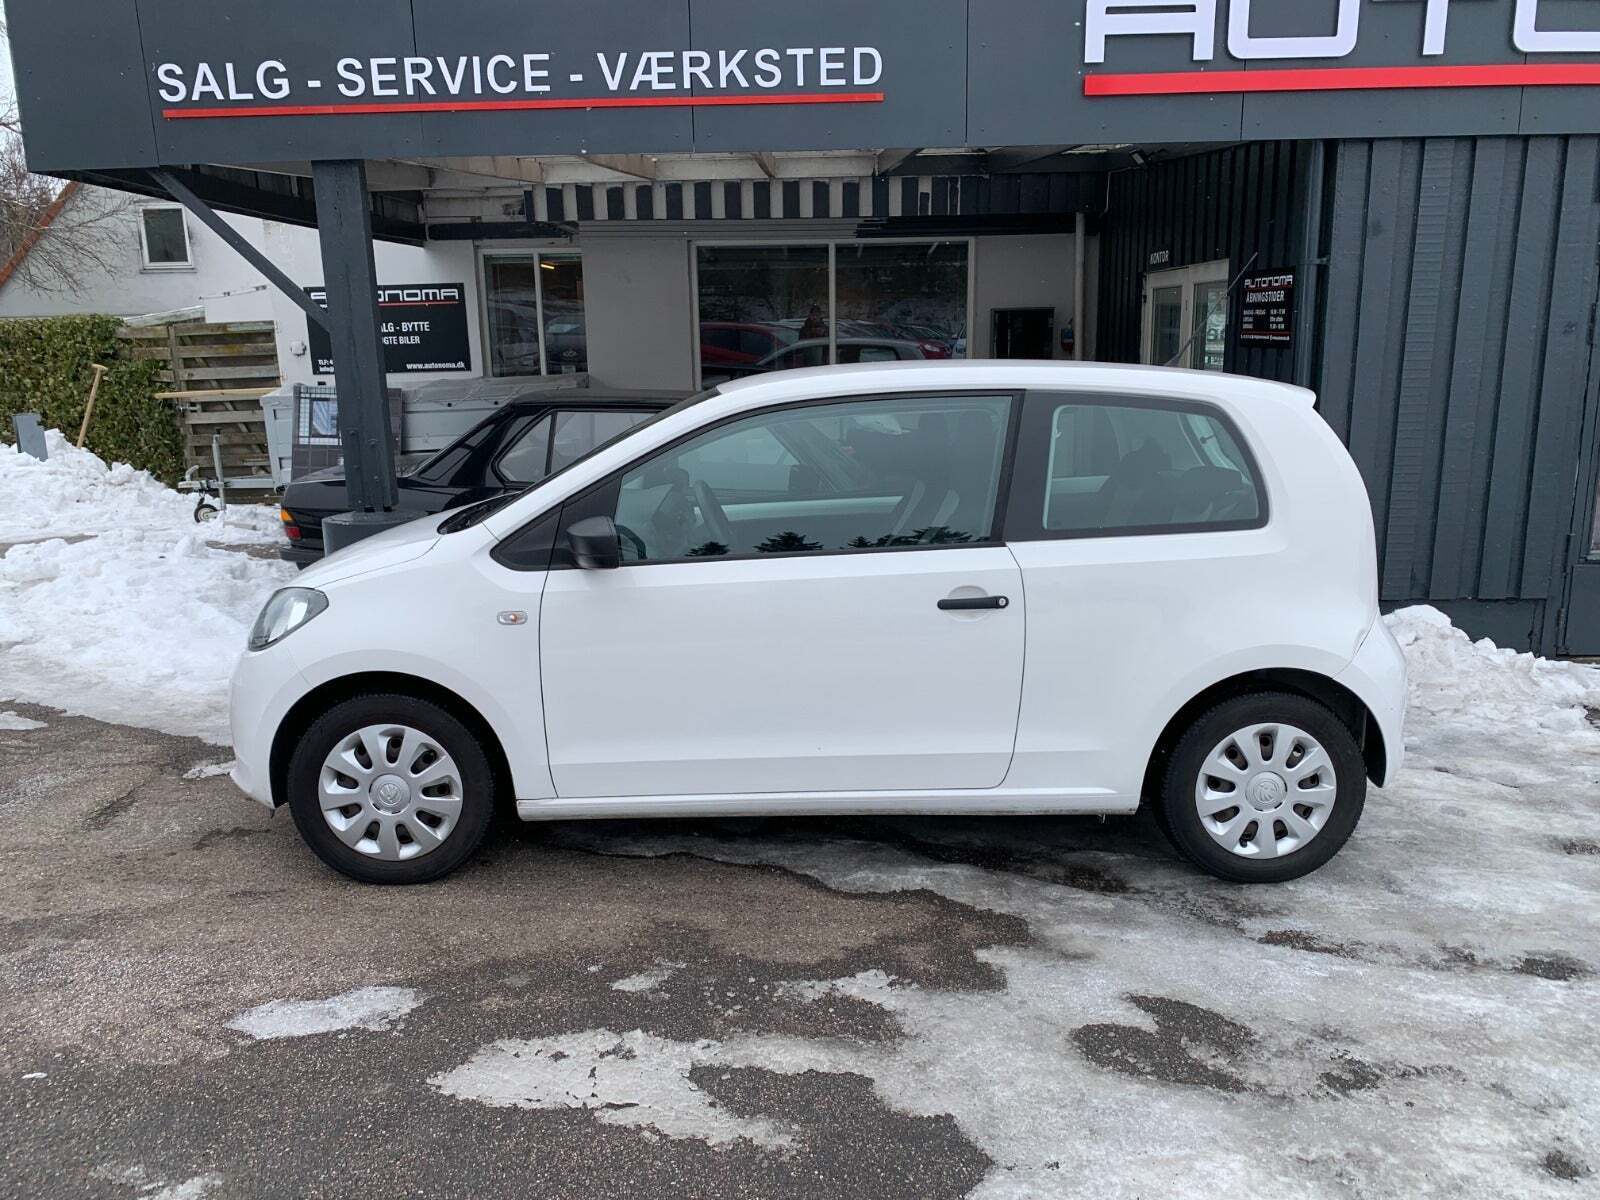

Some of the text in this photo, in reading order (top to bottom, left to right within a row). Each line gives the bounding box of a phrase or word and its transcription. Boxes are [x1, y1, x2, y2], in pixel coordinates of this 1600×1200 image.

[156, 46, 883, 102] SALG - SERVICE - VÆRKSTED
[1244, 274, 1294, 289] AUTONOMA
[402, 321, 430, 332] BYTTE
[399, 335, 421, 345] BILER
[406, 360, 465, 370] www.autonoma.dk
